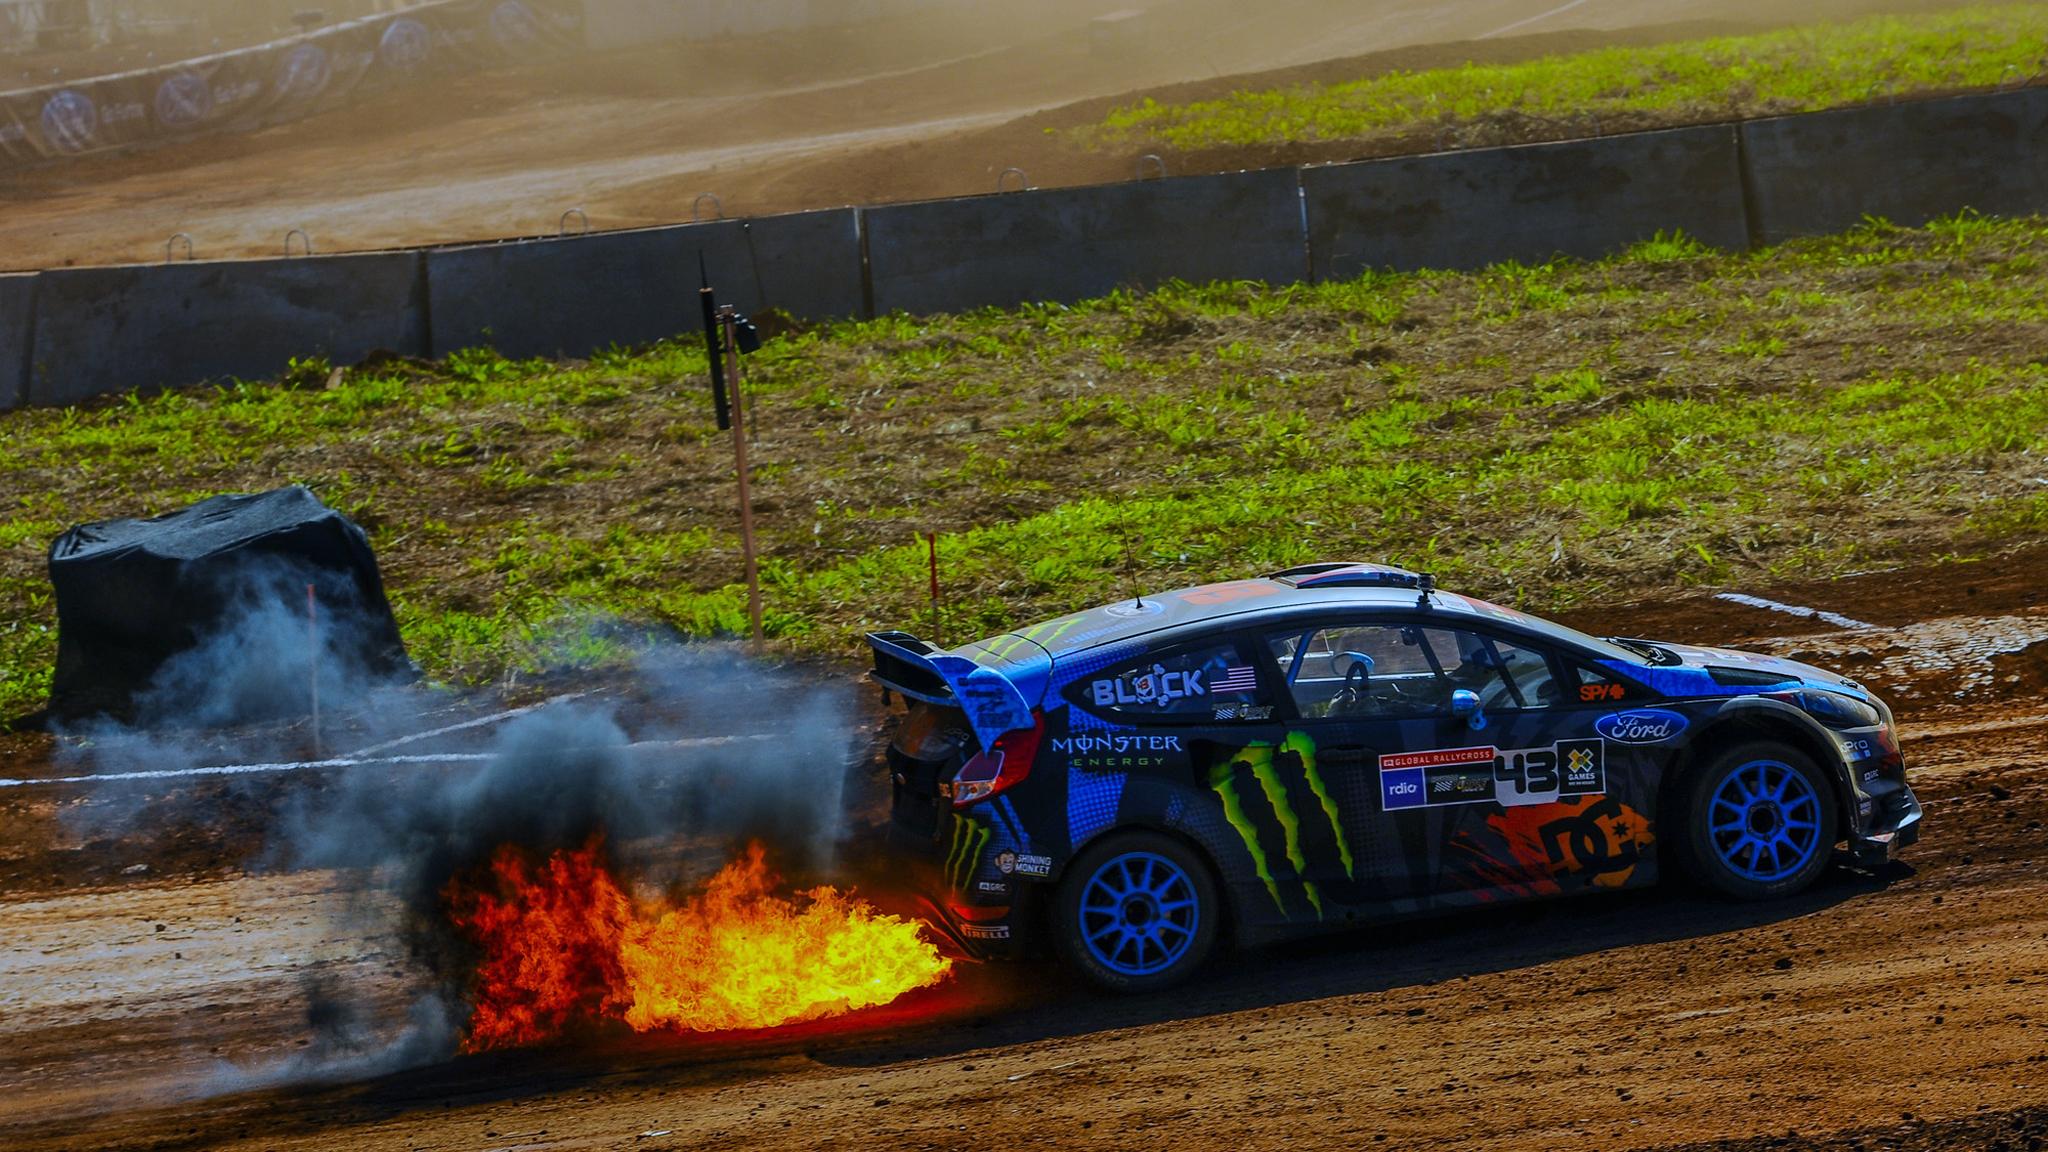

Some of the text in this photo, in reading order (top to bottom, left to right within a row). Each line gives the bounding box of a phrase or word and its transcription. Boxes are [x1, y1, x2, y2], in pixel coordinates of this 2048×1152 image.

[1091, 664, 1206, 707] BLOCK
[1612, 715, 1671, 738] Ford
[1051, 734, 1182, 754] MONSTER
[1073, 757, 1164, 767] ENERGY
[1394, 750, 1491, 766] GLOBAL RALLYCROSS
[1494, 751, 1559, 795] 43
[1568, 772, 1596, 781] GAMES
[1389, 782, 1418, 796] rdio
[1017, 854, 1052, 866] SHINING
[1014, 863, 1051, 875] MONKEY
